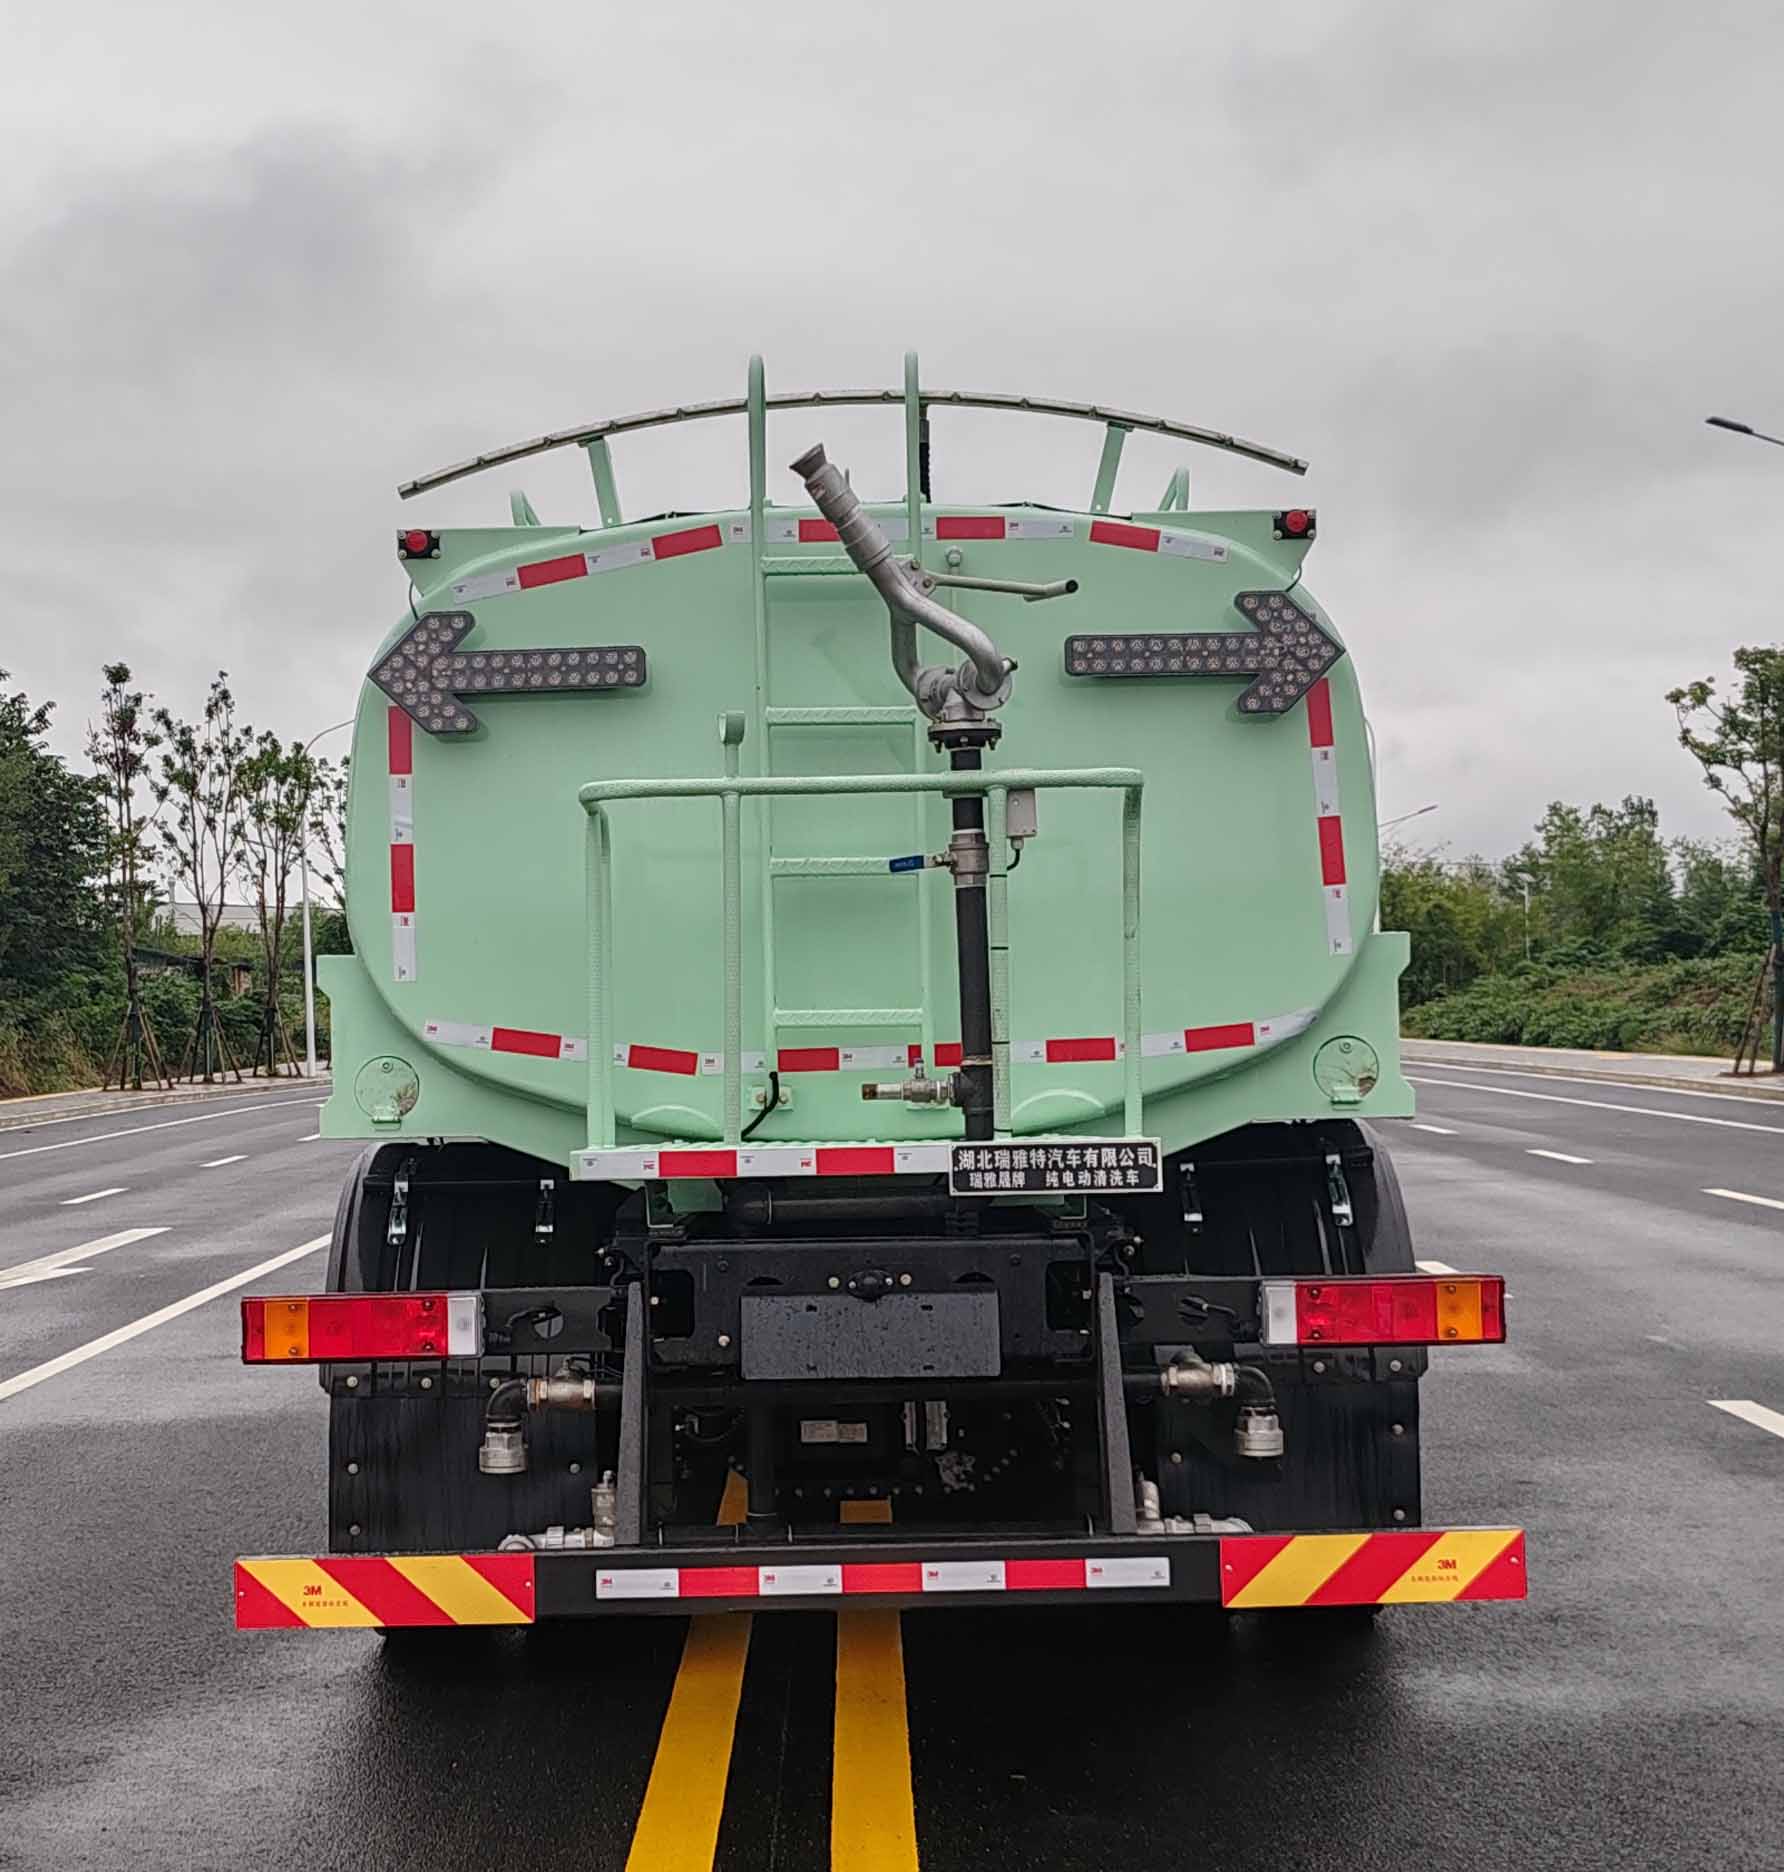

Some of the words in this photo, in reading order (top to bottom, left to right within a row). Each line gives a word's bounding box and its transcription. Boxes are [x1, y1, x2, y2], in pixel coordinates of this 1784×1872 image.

[958, 1148, 1153, 1170] 湖北瑞雅特汽车有限公司
[1046, 1170, 1139, 1188] 纯电动清洗车
[1438, 1559, 1456, 1569] 3M
[304, 1585, 322, 1596] 3M
